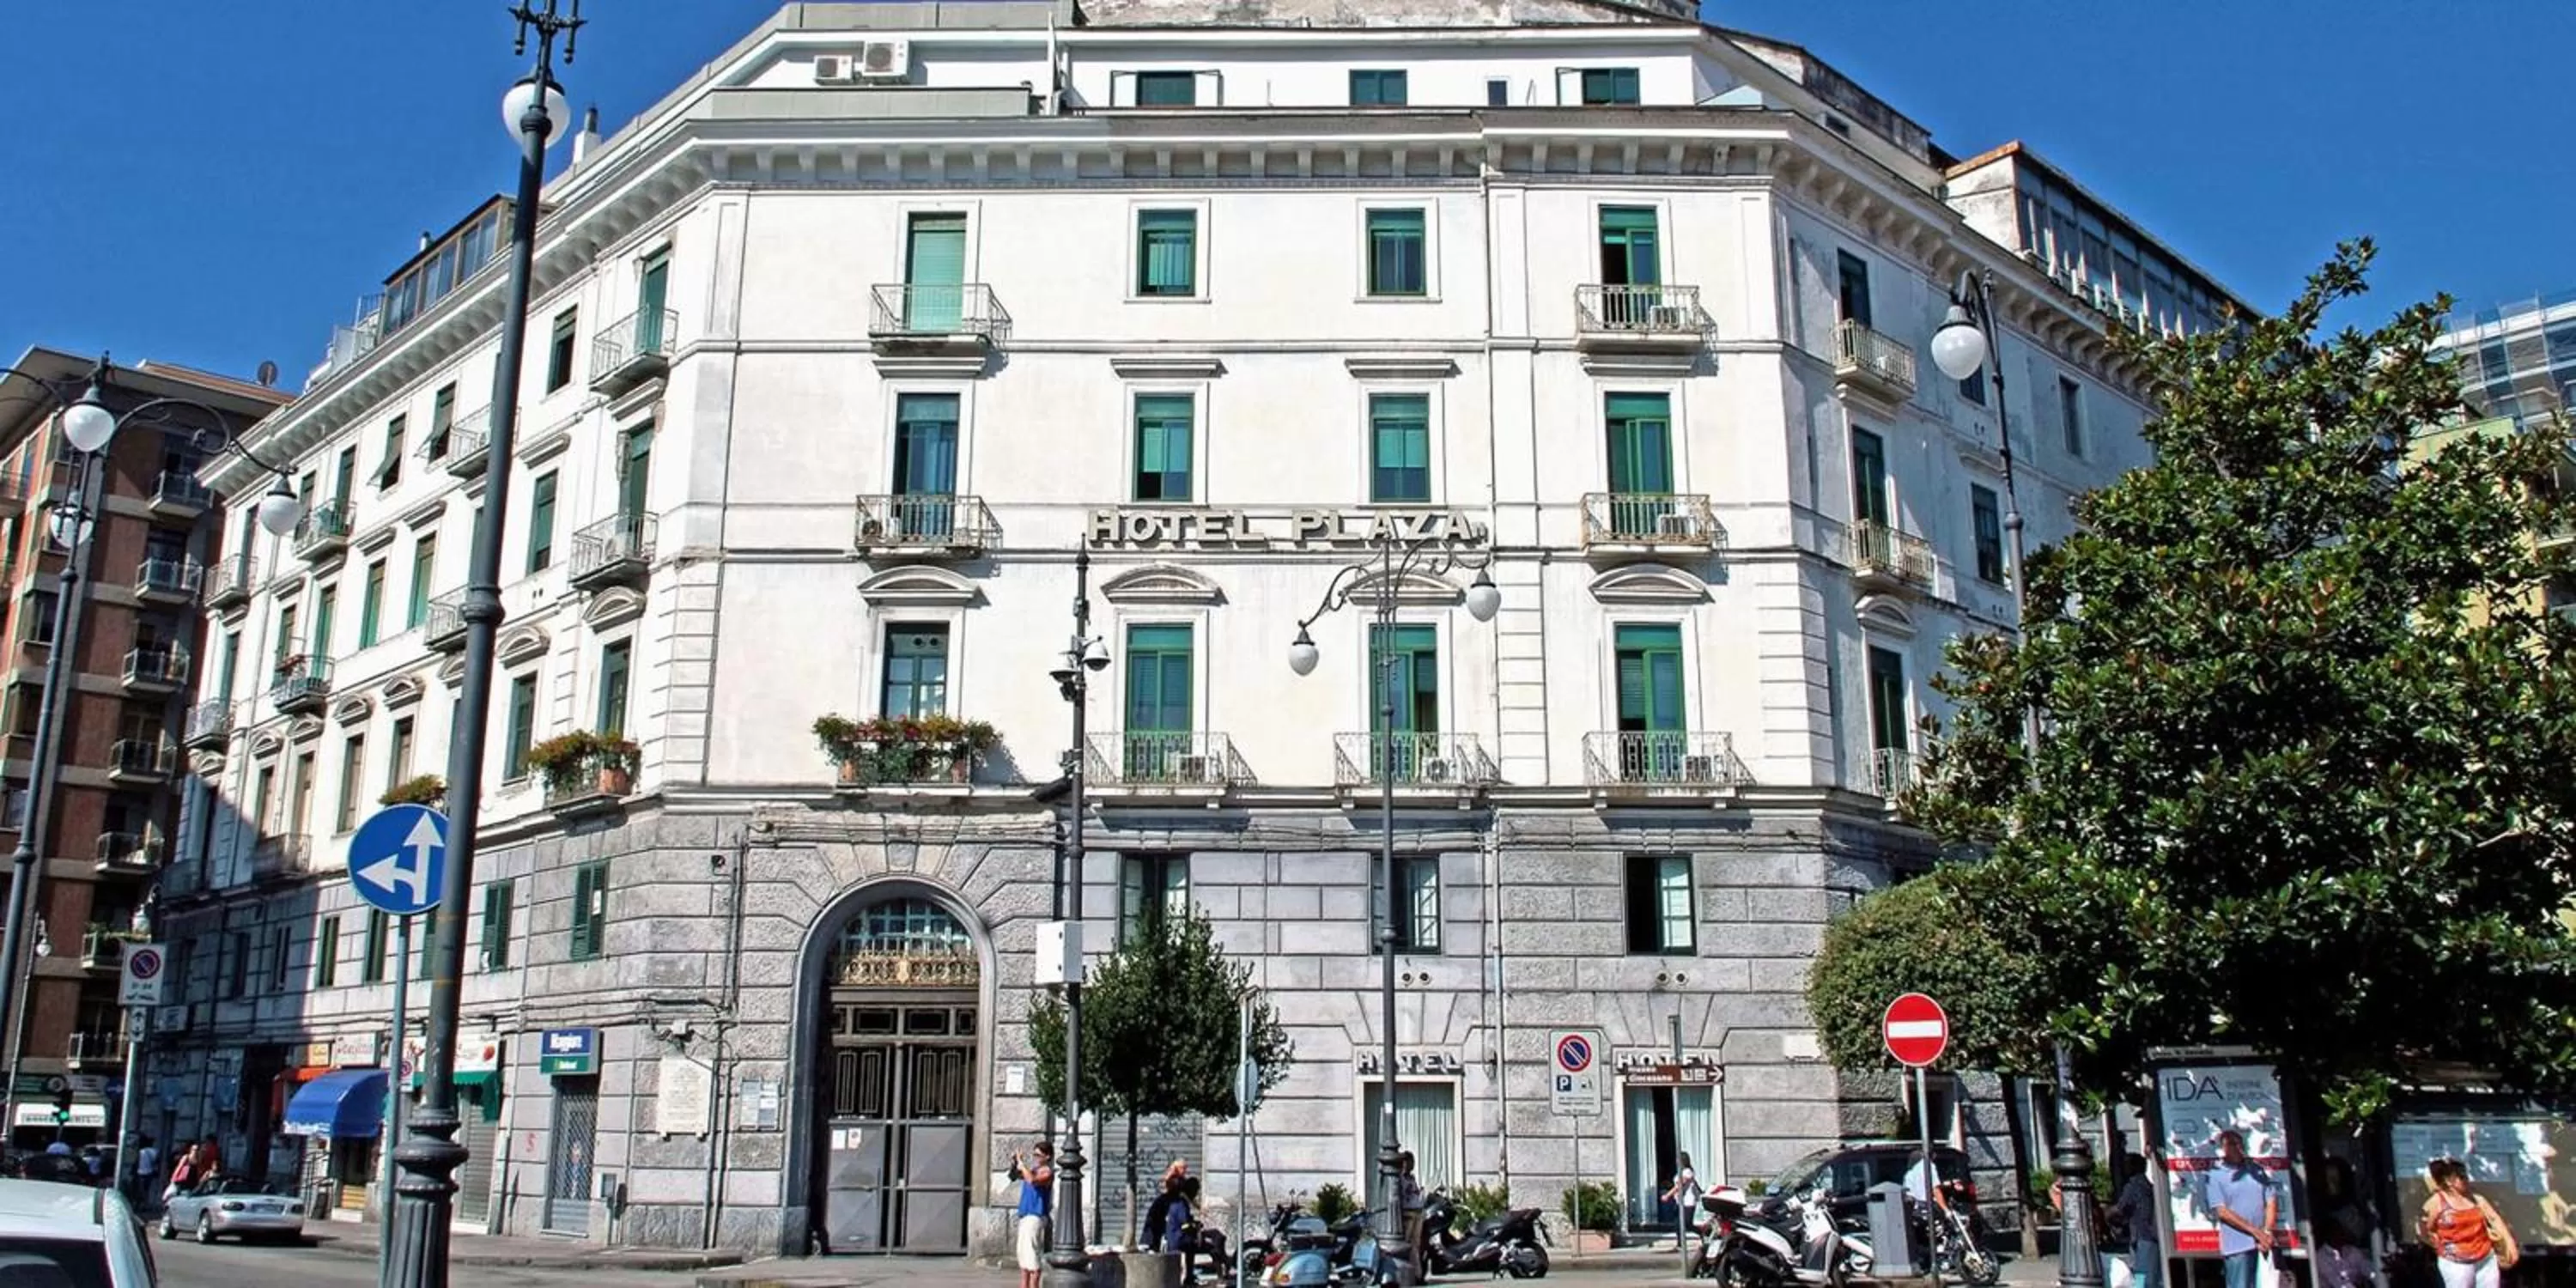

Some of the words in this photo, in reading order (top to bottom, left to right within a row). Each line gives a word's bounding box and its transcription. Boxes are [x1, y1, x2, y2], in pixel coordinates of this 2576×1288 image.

[1088, 508, 1266, 543] HOTEL
[1291, 507, 1473, 543] PLAZA
[1356, 1052, 1462, 1073] HTEL
[1558, 1077, 1570, 1090] P
